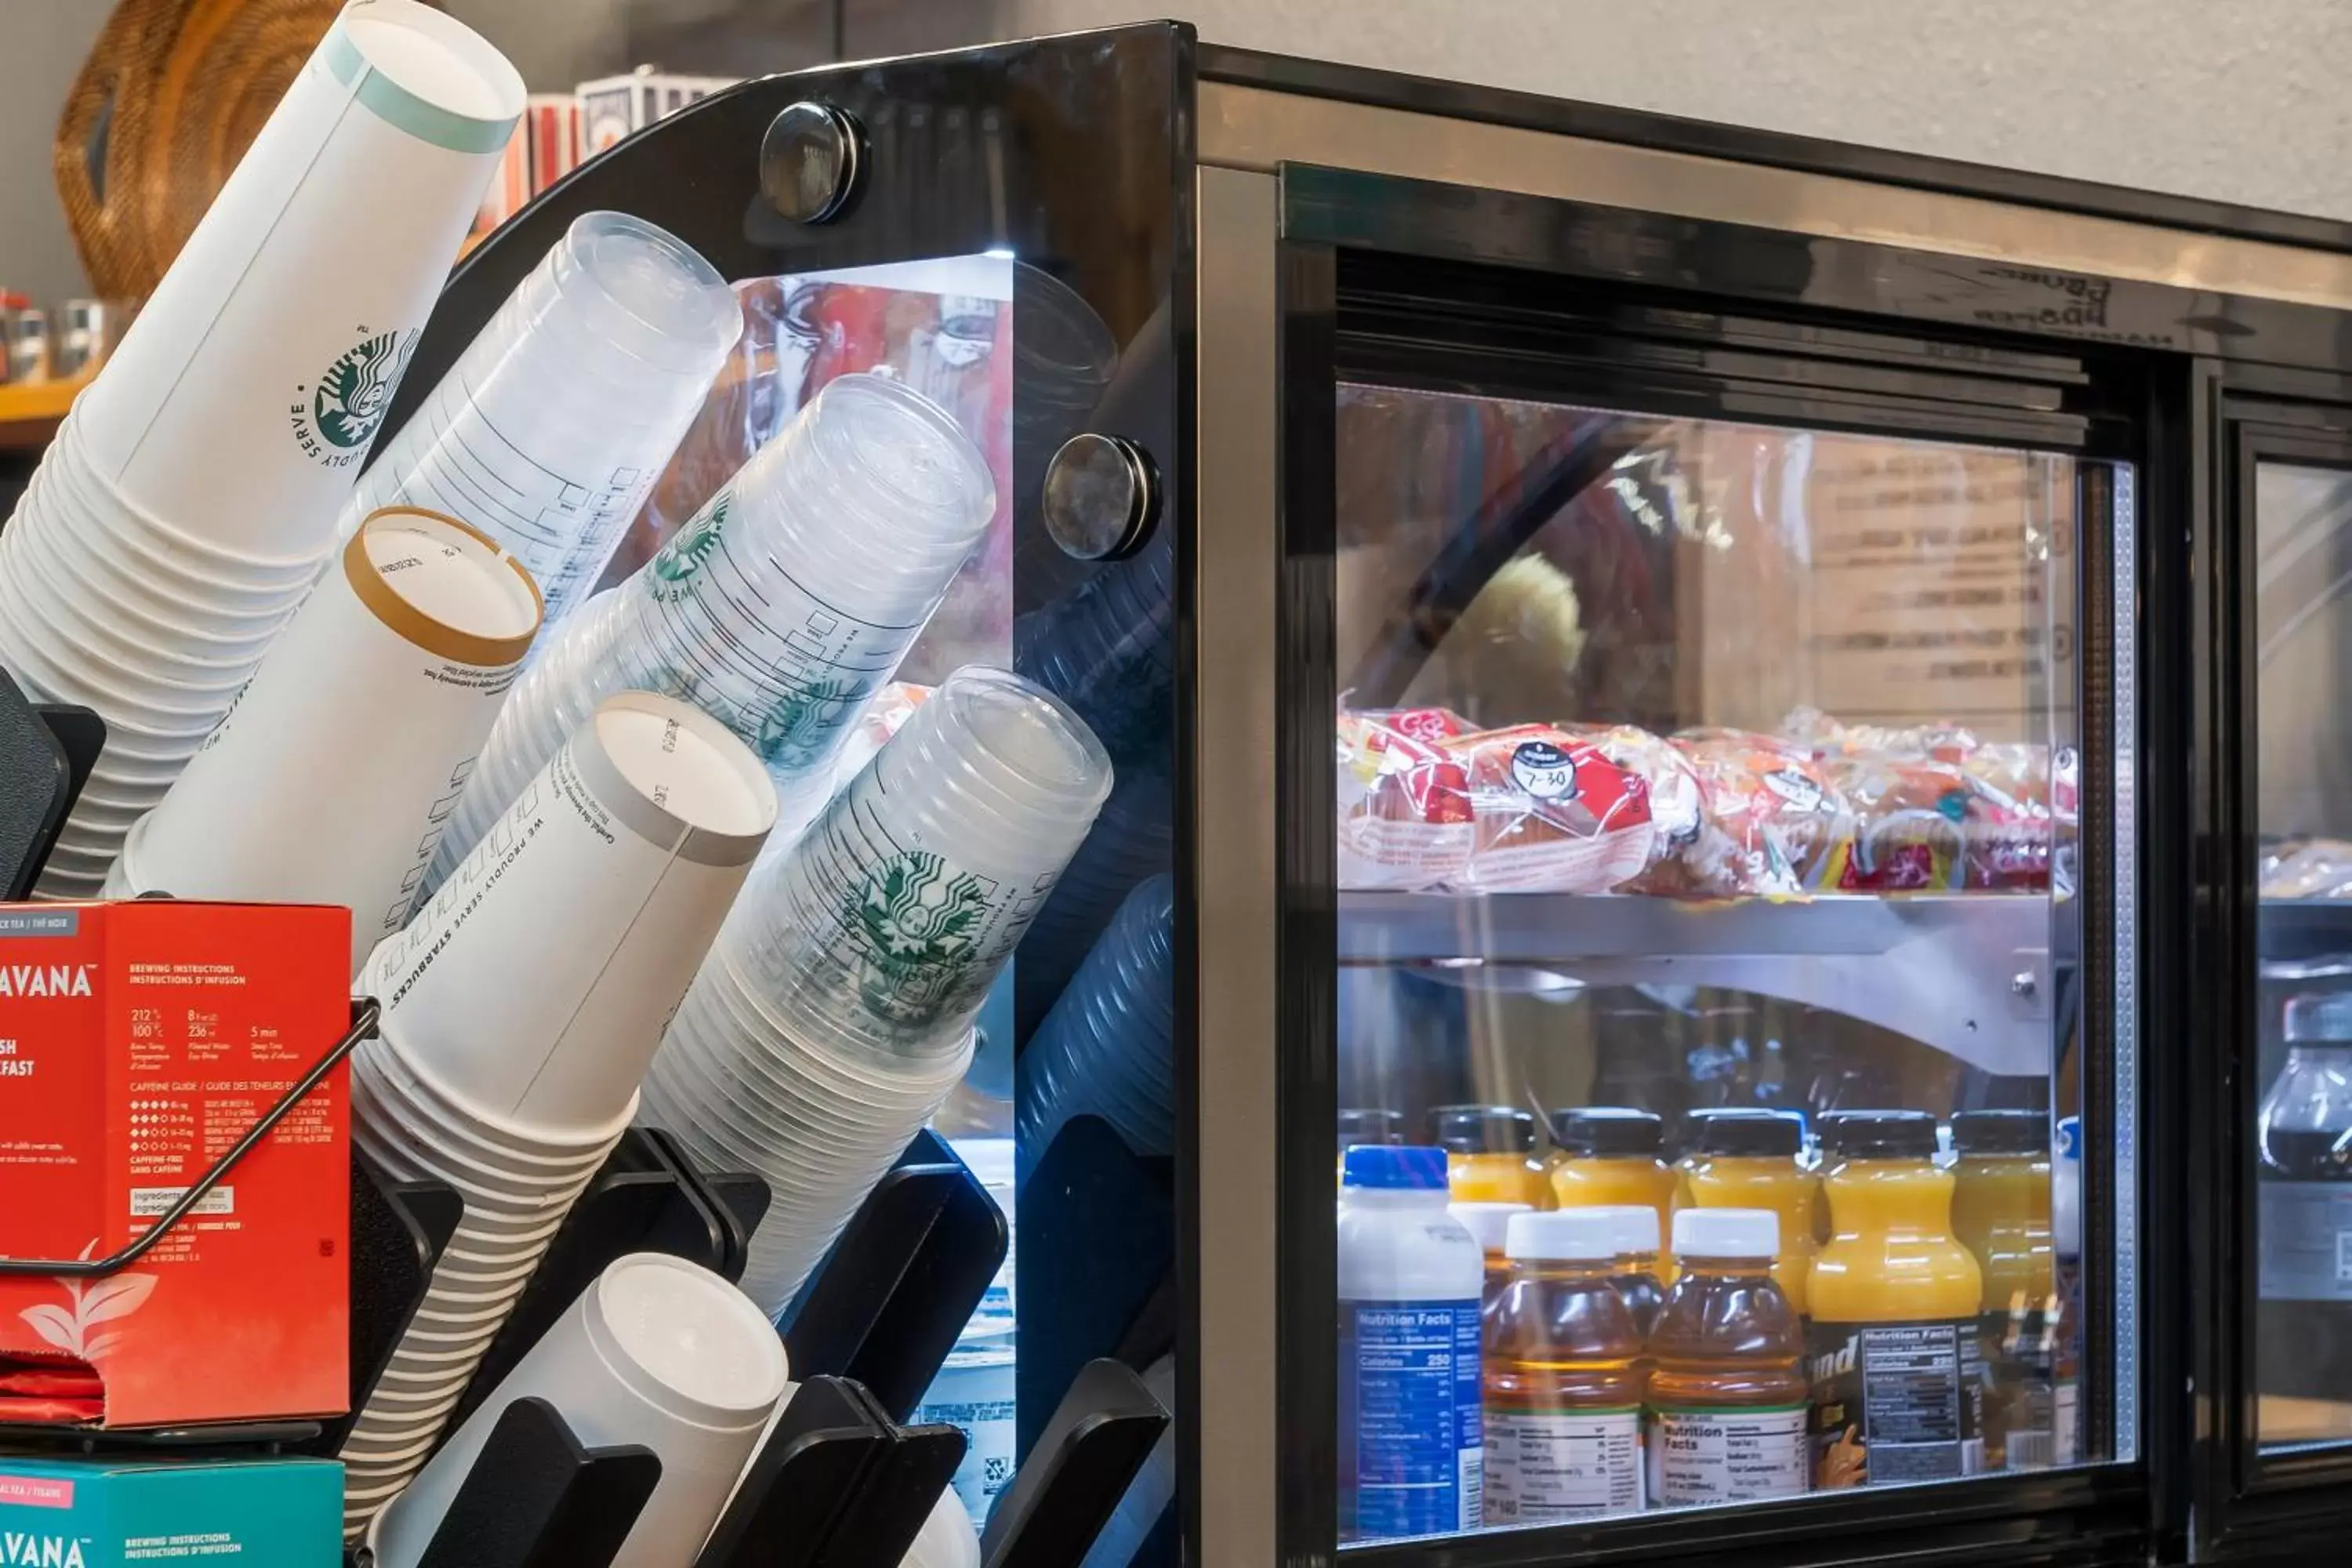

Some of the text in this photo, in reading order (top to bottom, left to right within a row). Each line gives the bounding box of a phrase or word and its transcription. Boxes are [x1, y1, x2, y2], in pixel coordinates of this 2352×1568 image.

[291, 404, 321, 458] SERVE
[1523, 771, 1566, 787] 7-30
[392, 818, 543, 1005] WE PROUDLY SERVE STARBUCKS
[129, 964, 234, 974] BREWING INSTRUCTIONS
[132, 1009, 151, 1021] 212
[188, 1010, 195, 1021] 8
[133, 1025, 151, 1036] 100
[188, 1026, 207, 1037] 236
[251, 1026, 278, 1037] 5 min
[0, 1061, 34, 1076] FAST
[130, 1083, 169, 1092] CAFFEINE
[172, 1082, 197, 1091] GUIDE
[206, 1082, 230, 1091] GUIDE
[1359, 1313, 1451, 1326] Nutrition Facts
[1427, 1354, 1450, 1367] 250
[1664, 1425, 1722, 1438] Nutrition
[1664, 1439, 1699, 1450] Facts
[125, 1532, 230, 1548] BREWING INSTRUCTIONS
[0, 1531, 85, 1568] VANA
[125, 1542, 242, 1559] INSTRUCTIONS D'INFUSION
